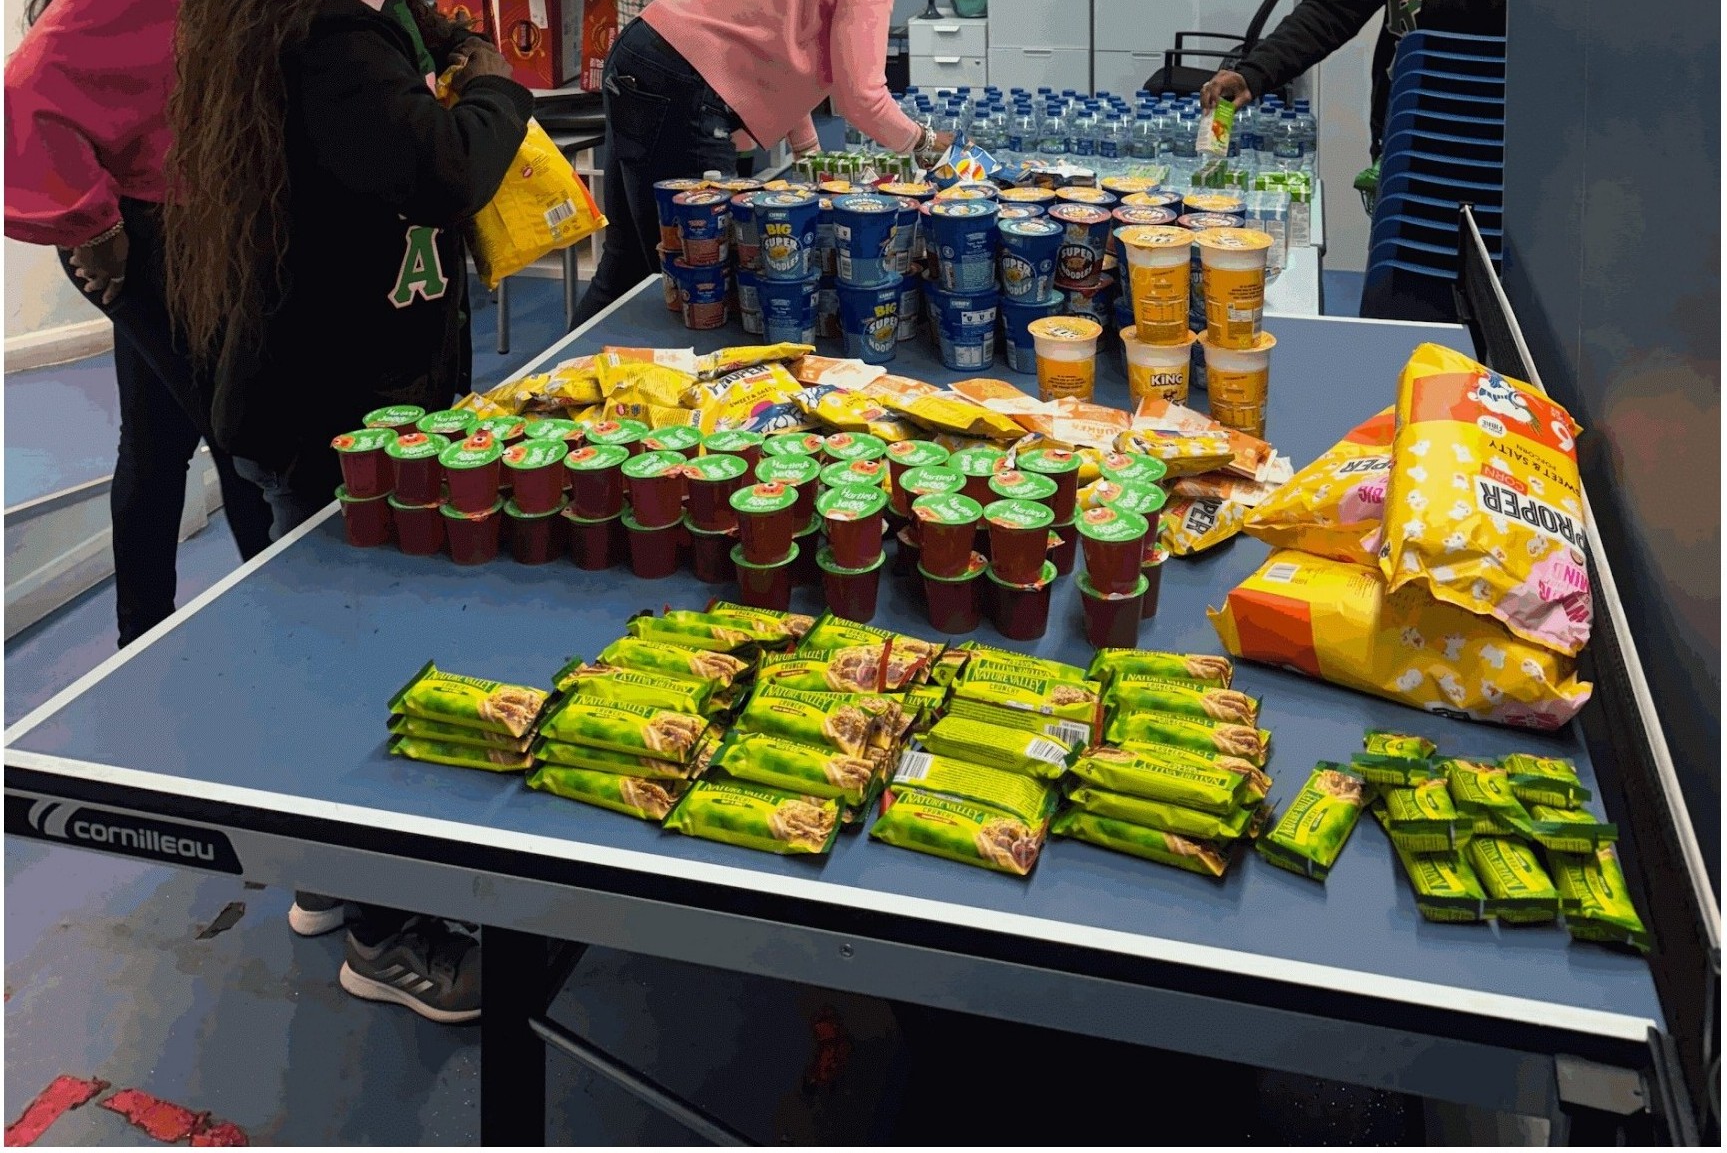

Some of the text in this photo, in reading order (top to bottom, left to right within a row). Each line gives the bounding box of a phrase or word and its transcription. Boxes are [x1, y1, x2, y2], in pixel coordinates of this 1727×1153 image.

[765, 223, 792, 236] BIG
[765, 236, 798, 248] SUPER
[1061, 247, 1093, 259] SUPER
[388, 225, 449, 309] A
[1002, 257, 1031, 277] SUPER
[873, 302, 897, 318] BIG
[1485, 466, 1526, 493] CORN
[1489, 440, 1581, 497] SWEET & SALTY
[1479, 480, 1587, 548] PROPER
[766, 650, 826, 662] NATURE VALLEY
[971, 669, 1043, 693] NATURE VALLEY
[578, 695, 649, 717] NATURE VALLEY
[765, 685, 831, 711] NATURE VALLEY
[904, 792, 979, 821] NATURE VALLEY
[73, 820, 215, 861] cornilleau
